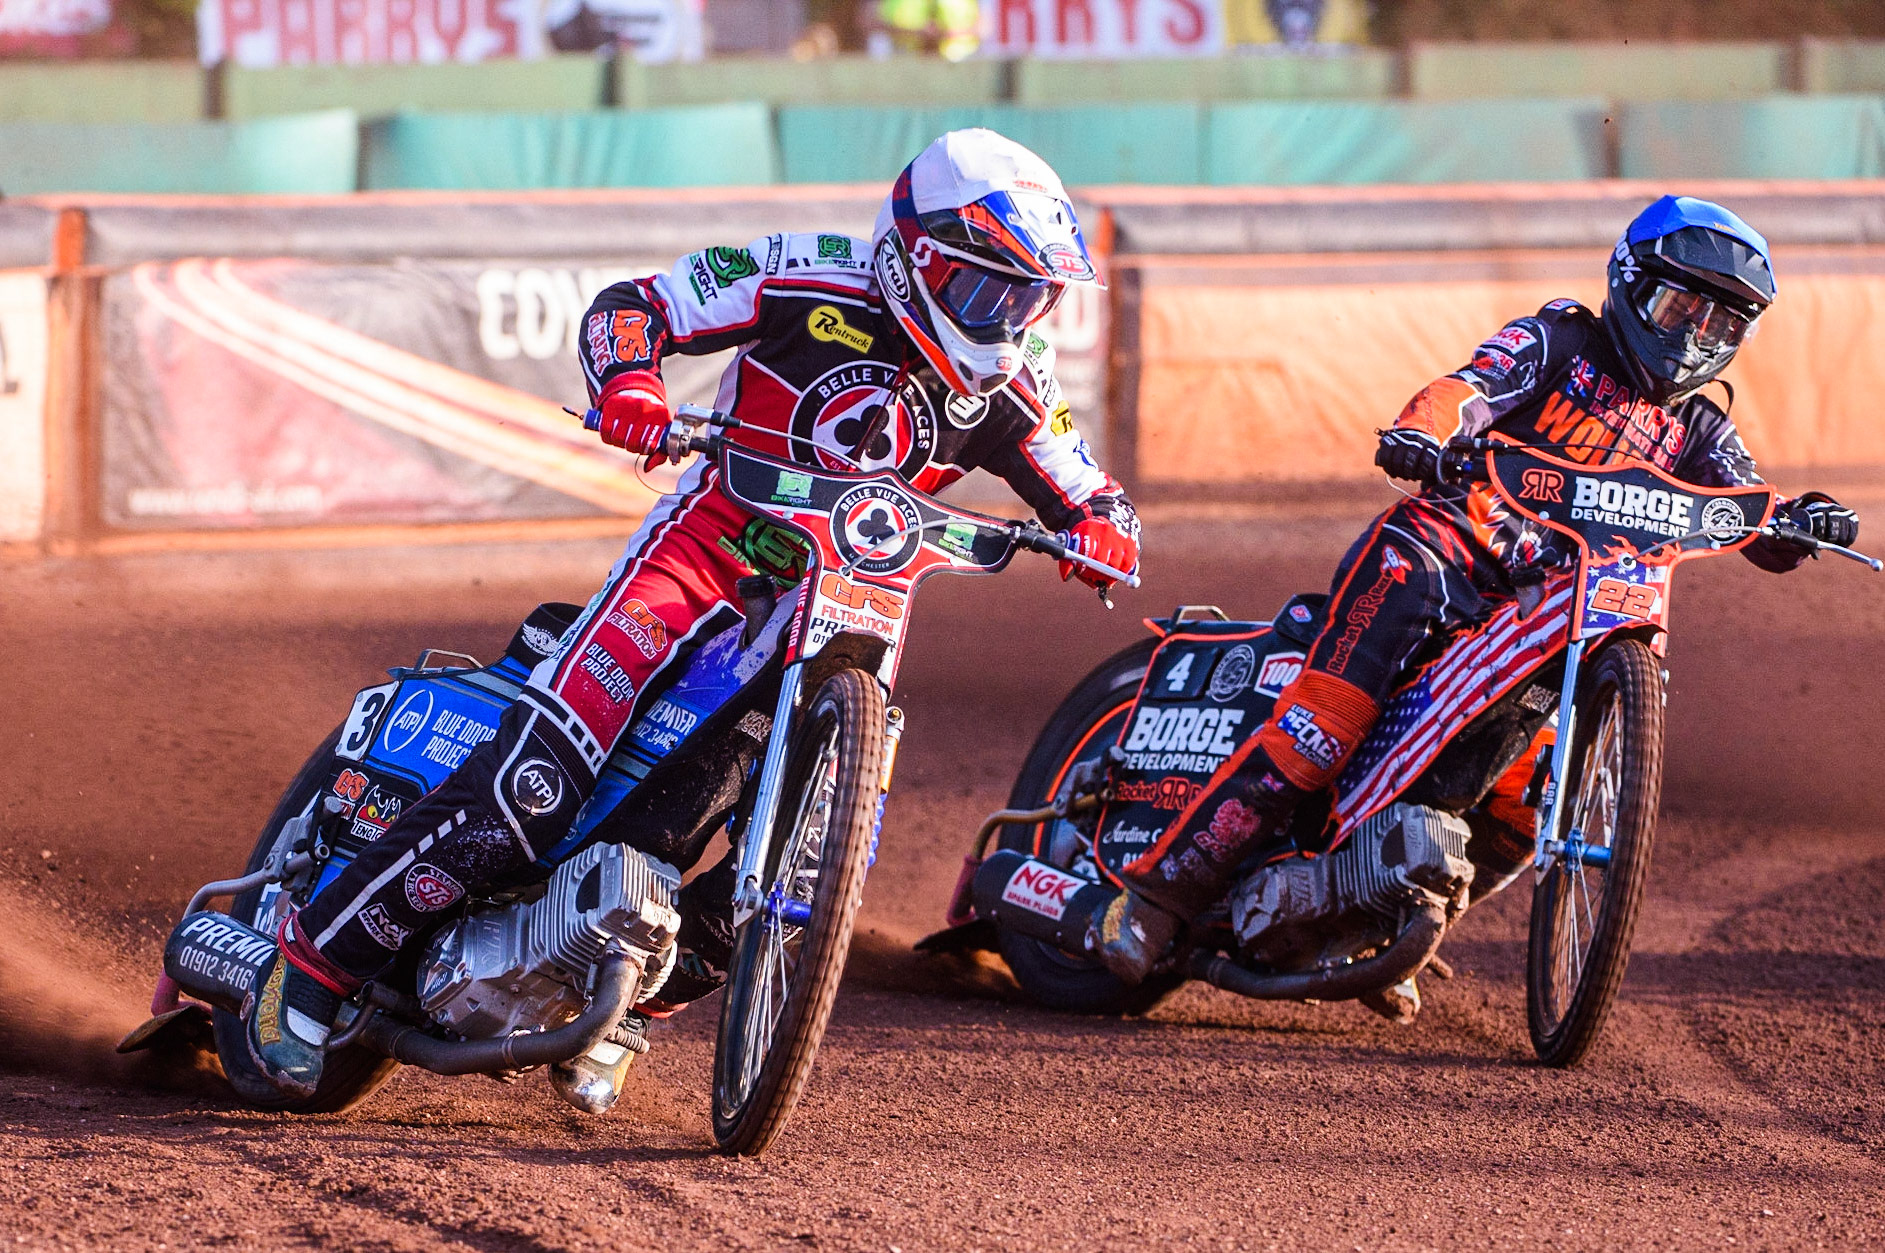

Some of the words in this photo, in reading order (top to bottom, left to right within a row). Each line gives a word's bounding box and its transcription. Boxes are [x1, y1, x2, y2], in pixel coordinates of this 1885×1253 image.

[690, 251, 718, 299] ERIGHT
[883, 250, 909, 296] Arai
[1049, 254, 1085, 270] STS
[1615, 231, 1642, 284] 00%
[814, 310, 870, 349] Rentruck
[817, 367, 872, 399] BELLE
[883, 370, 915, 400] VE
[911, 405, 931, 451] ACES
[841, 487, 872, 512] BELLE
[876, 488, 899, 503] VUE
[900, 502, 918, 529] ACES
[1571, 476, 1694, 527] BORGE
[1571, 507, 1690, 538] DEVELOPMENT
[848, 552, 890, 569] MCHESTER
[820, 573, 904, 620] CFS
[1592, 579, 1657, 618] 22
[606, 612, 656, 660] FILTRATION
[621, 599, 668, 651] CFS
[821, 604, 894, 635] FILTRATION
[1326, 626, 1363, 675] Rocket
[580, 659, 624, 705] PROJECT
[586, 643, 616, 673] BLUE
[609, 666, 636, 703] DOOR
[1166, 652, 1195, 692] 4
[1262, 661, 1303, 687] 100
[347, 692, 386, 752] 3
[394, 710, 424, 733] ATPI
[432, 709, 461, 739] BLUE
[645, 700, 698, 737] REMIER
[1124, 706, 1245, 756] BORGE
[1291, 703, 1316, 721] LUKE
[1293, 741, 1332, 771] RACING
[333, 768, 370, 802] CFS
[522, 768, 556, 807] ATPI
[1116, 780, 1157, 801] Rocket
[419, 881, 451, 905] STS
[1013, 865, 1078, 907] NGK
[180, 916, 278, 968] PREMI
[179, 945, 218, 979] 01912
[217, 961, 256, 991] 3416
